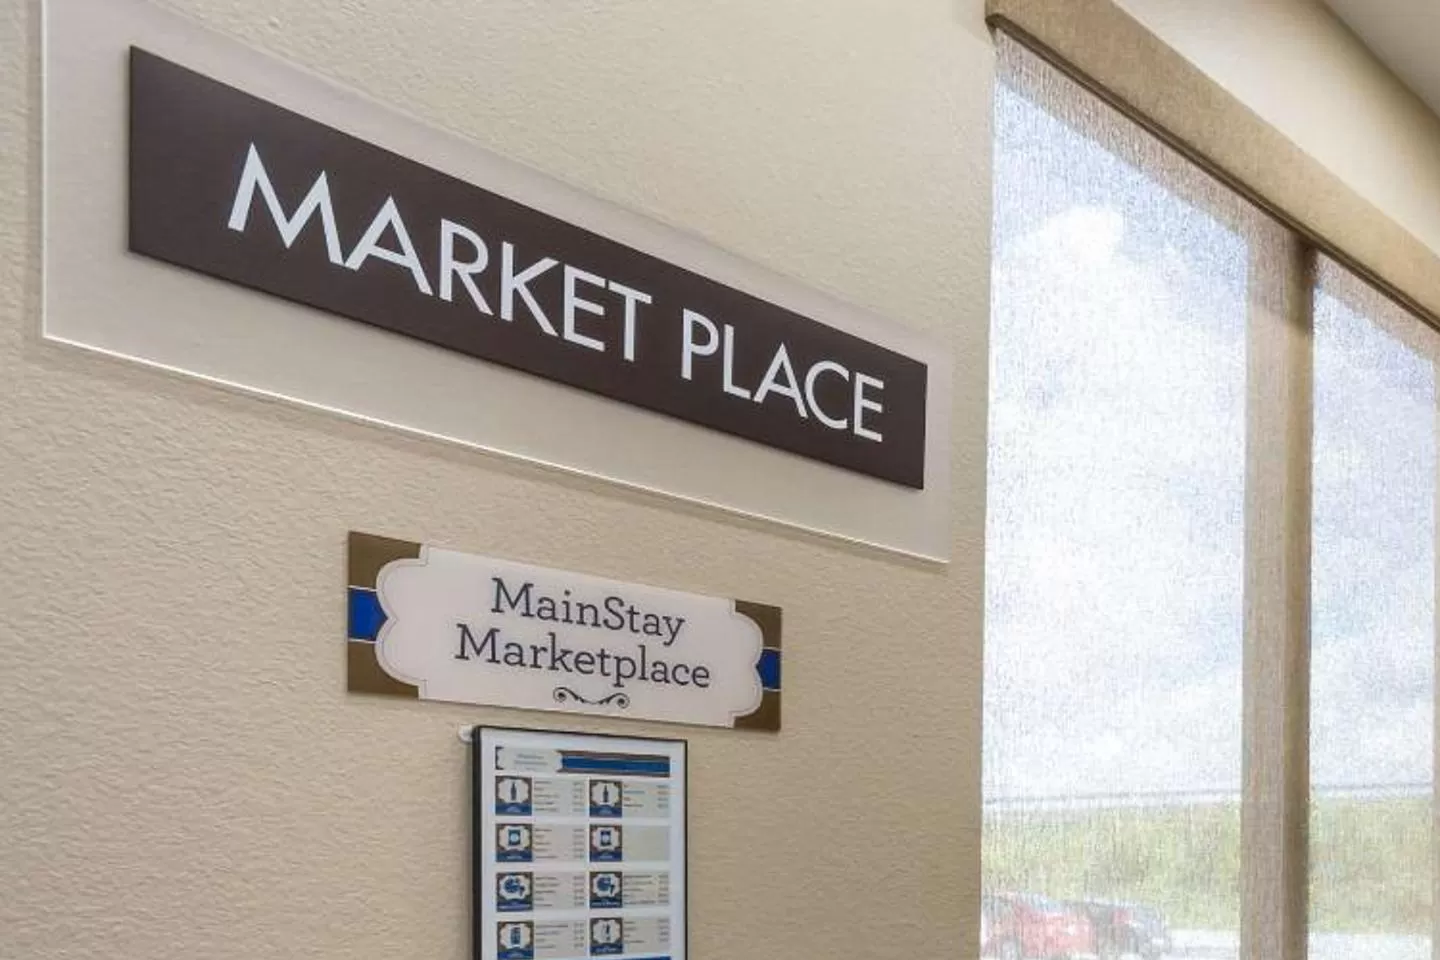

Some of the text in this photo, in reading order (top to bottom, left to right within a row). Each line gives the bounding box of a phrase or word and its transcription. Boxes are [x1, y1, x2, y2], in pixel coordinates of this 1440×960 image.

[227, 142, 885, 442] MARKET PLACE
[490, 577, 685, 646] MainStay
[454, 623, 711, 688] Marketplace
